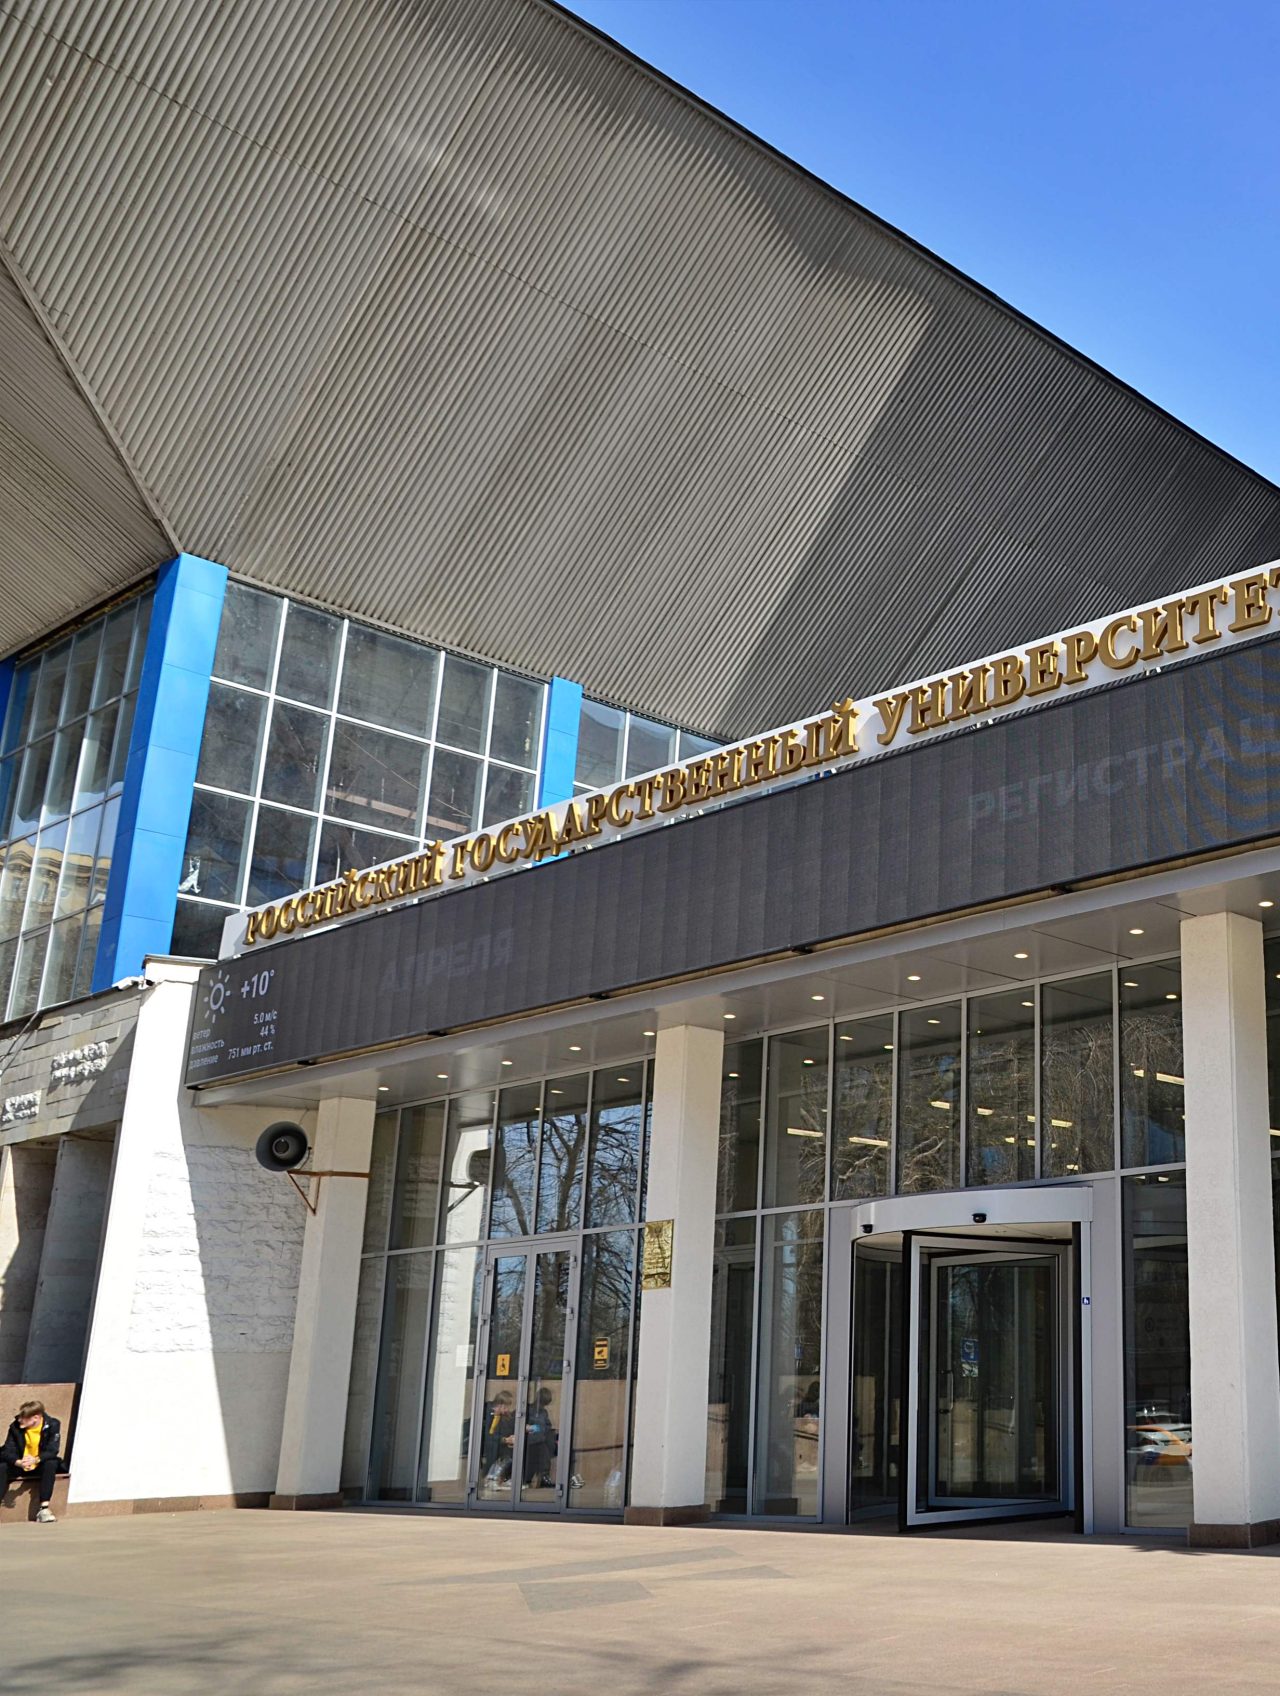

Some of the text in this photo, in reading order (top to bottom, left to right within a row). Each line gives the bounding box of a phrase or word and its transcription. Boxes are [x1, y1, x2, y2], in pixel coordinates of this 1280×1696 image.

[243, 840, 446, 945] РОССИЙСКИЙ
[449, 698, 861, 880] ГОСУДАРСТВЕННЫЙ
[378, 928, 514, 1005] АПРЕЛЯ
[241, 969, 275, 998] +10°
[253, 1012, 264, 1024] 5.0
[260, 1025, 269, 1037] 44
[228, 1047, 240, 1060] 751
